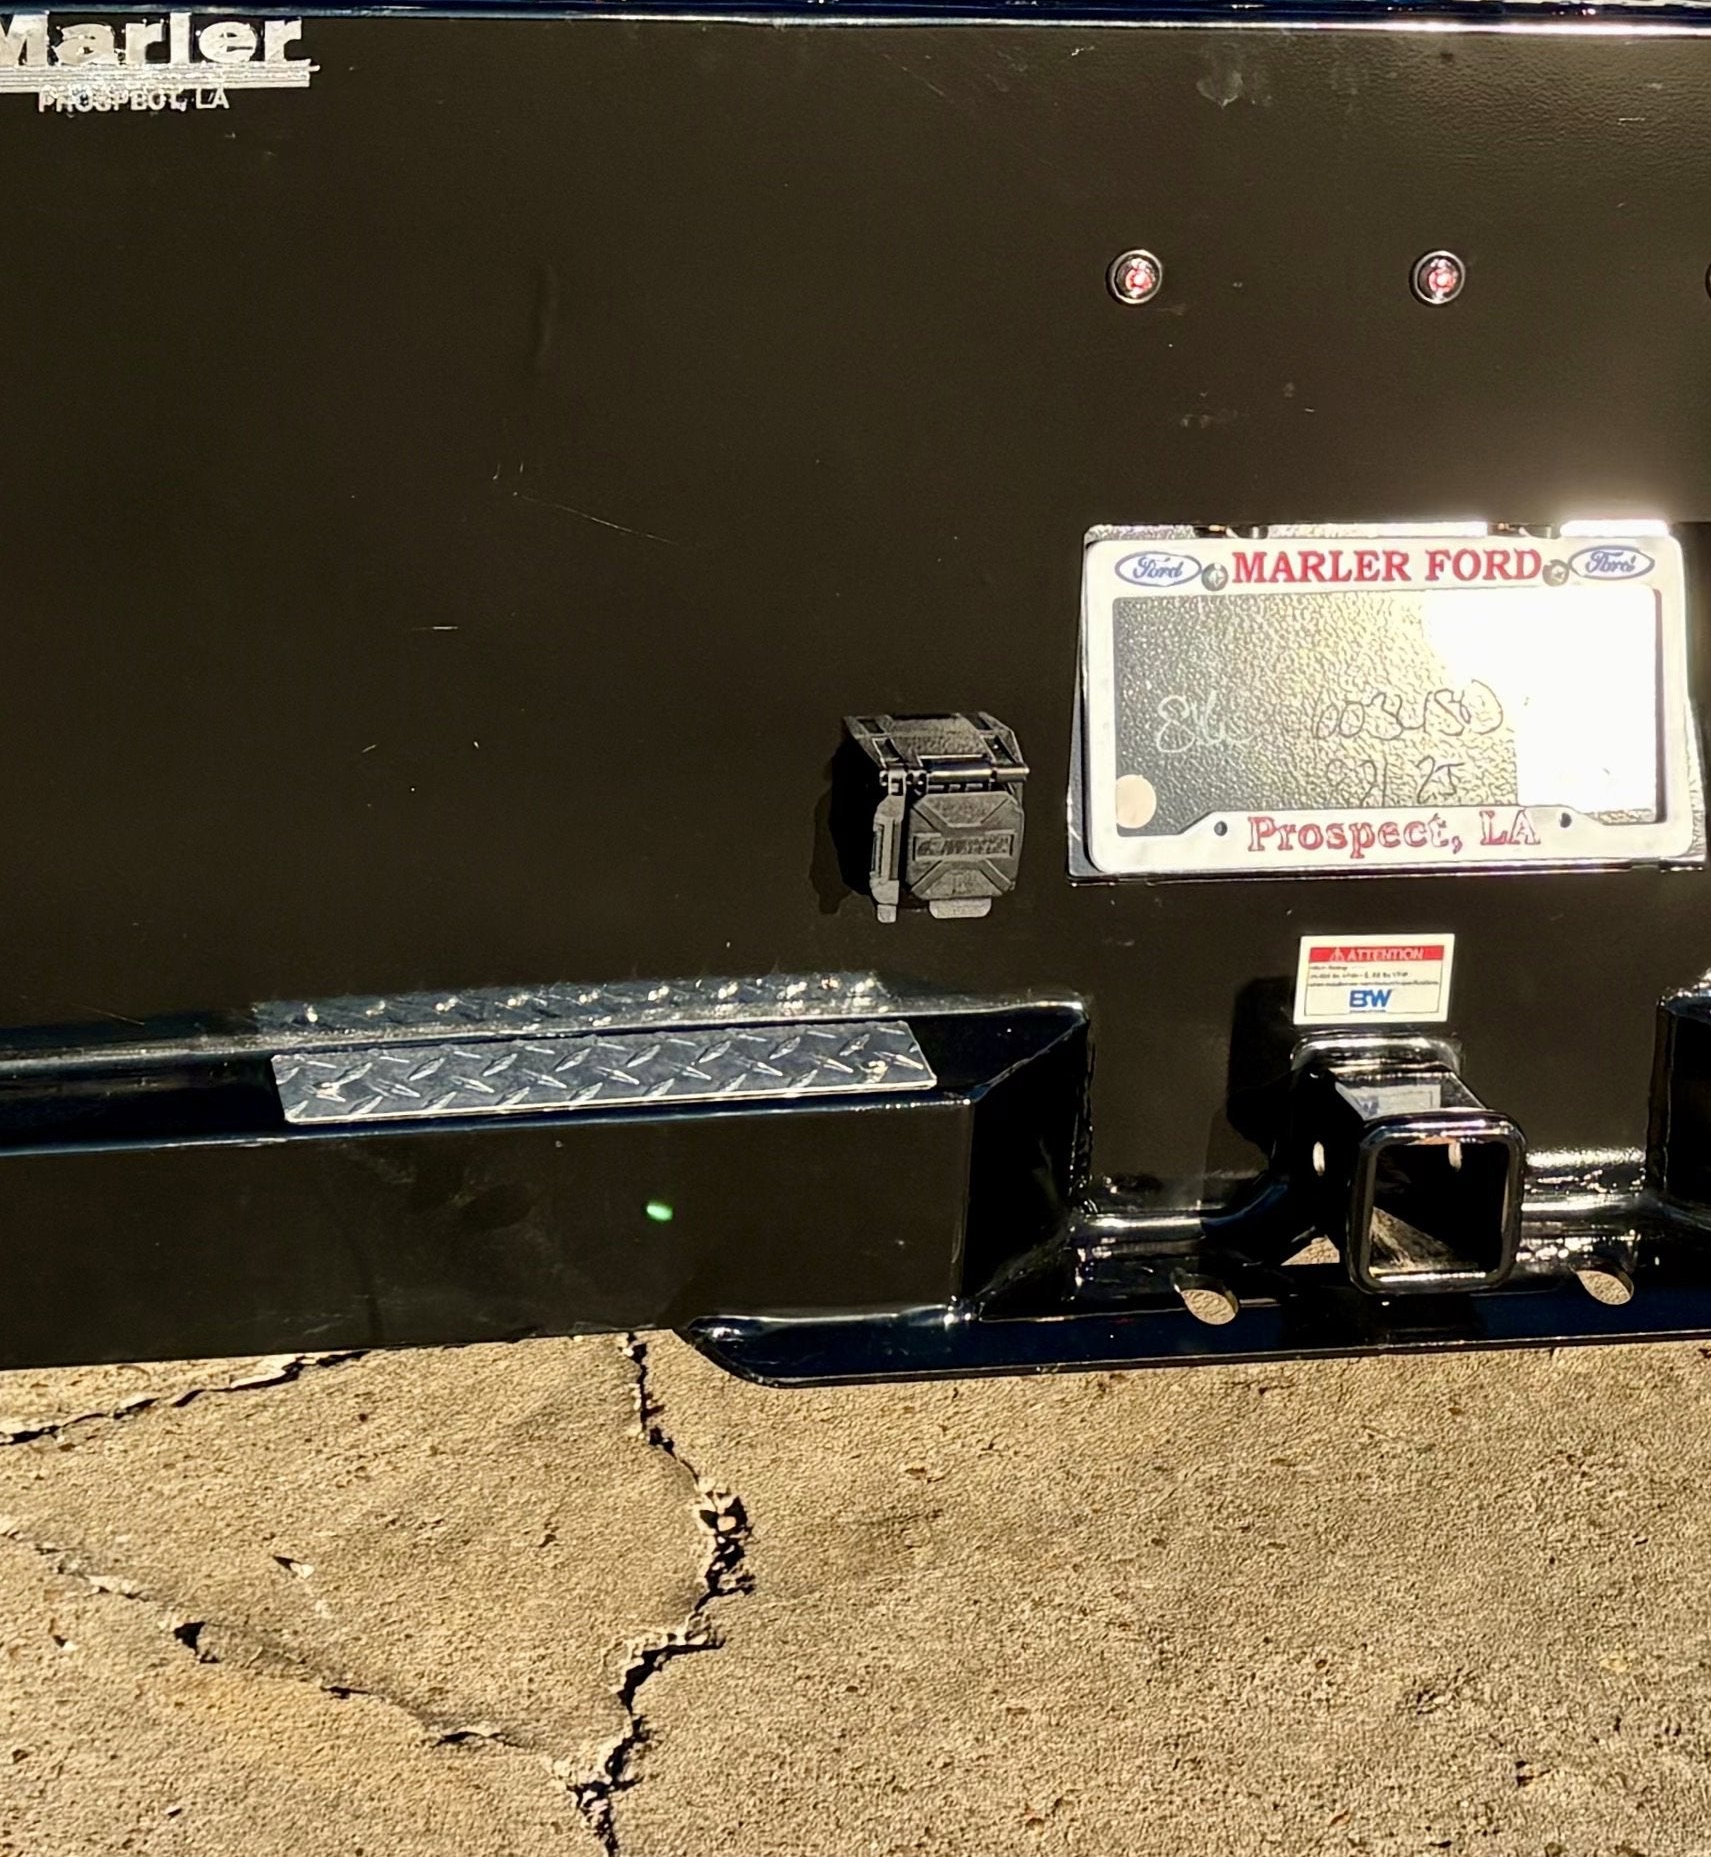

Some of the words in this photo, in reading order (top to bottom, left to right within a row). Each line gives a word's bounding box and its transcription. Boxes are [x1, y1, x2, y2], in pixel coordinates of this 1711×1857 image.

[1231, 550, 1411, 585] MARLER
[1424, 549, 1542, 582] FORD
[1249, 812, 1464, 859] Prospect,
[1479, 810, 1540, 846] LA
[1346, 947, 1425, 961] ATTENTION
